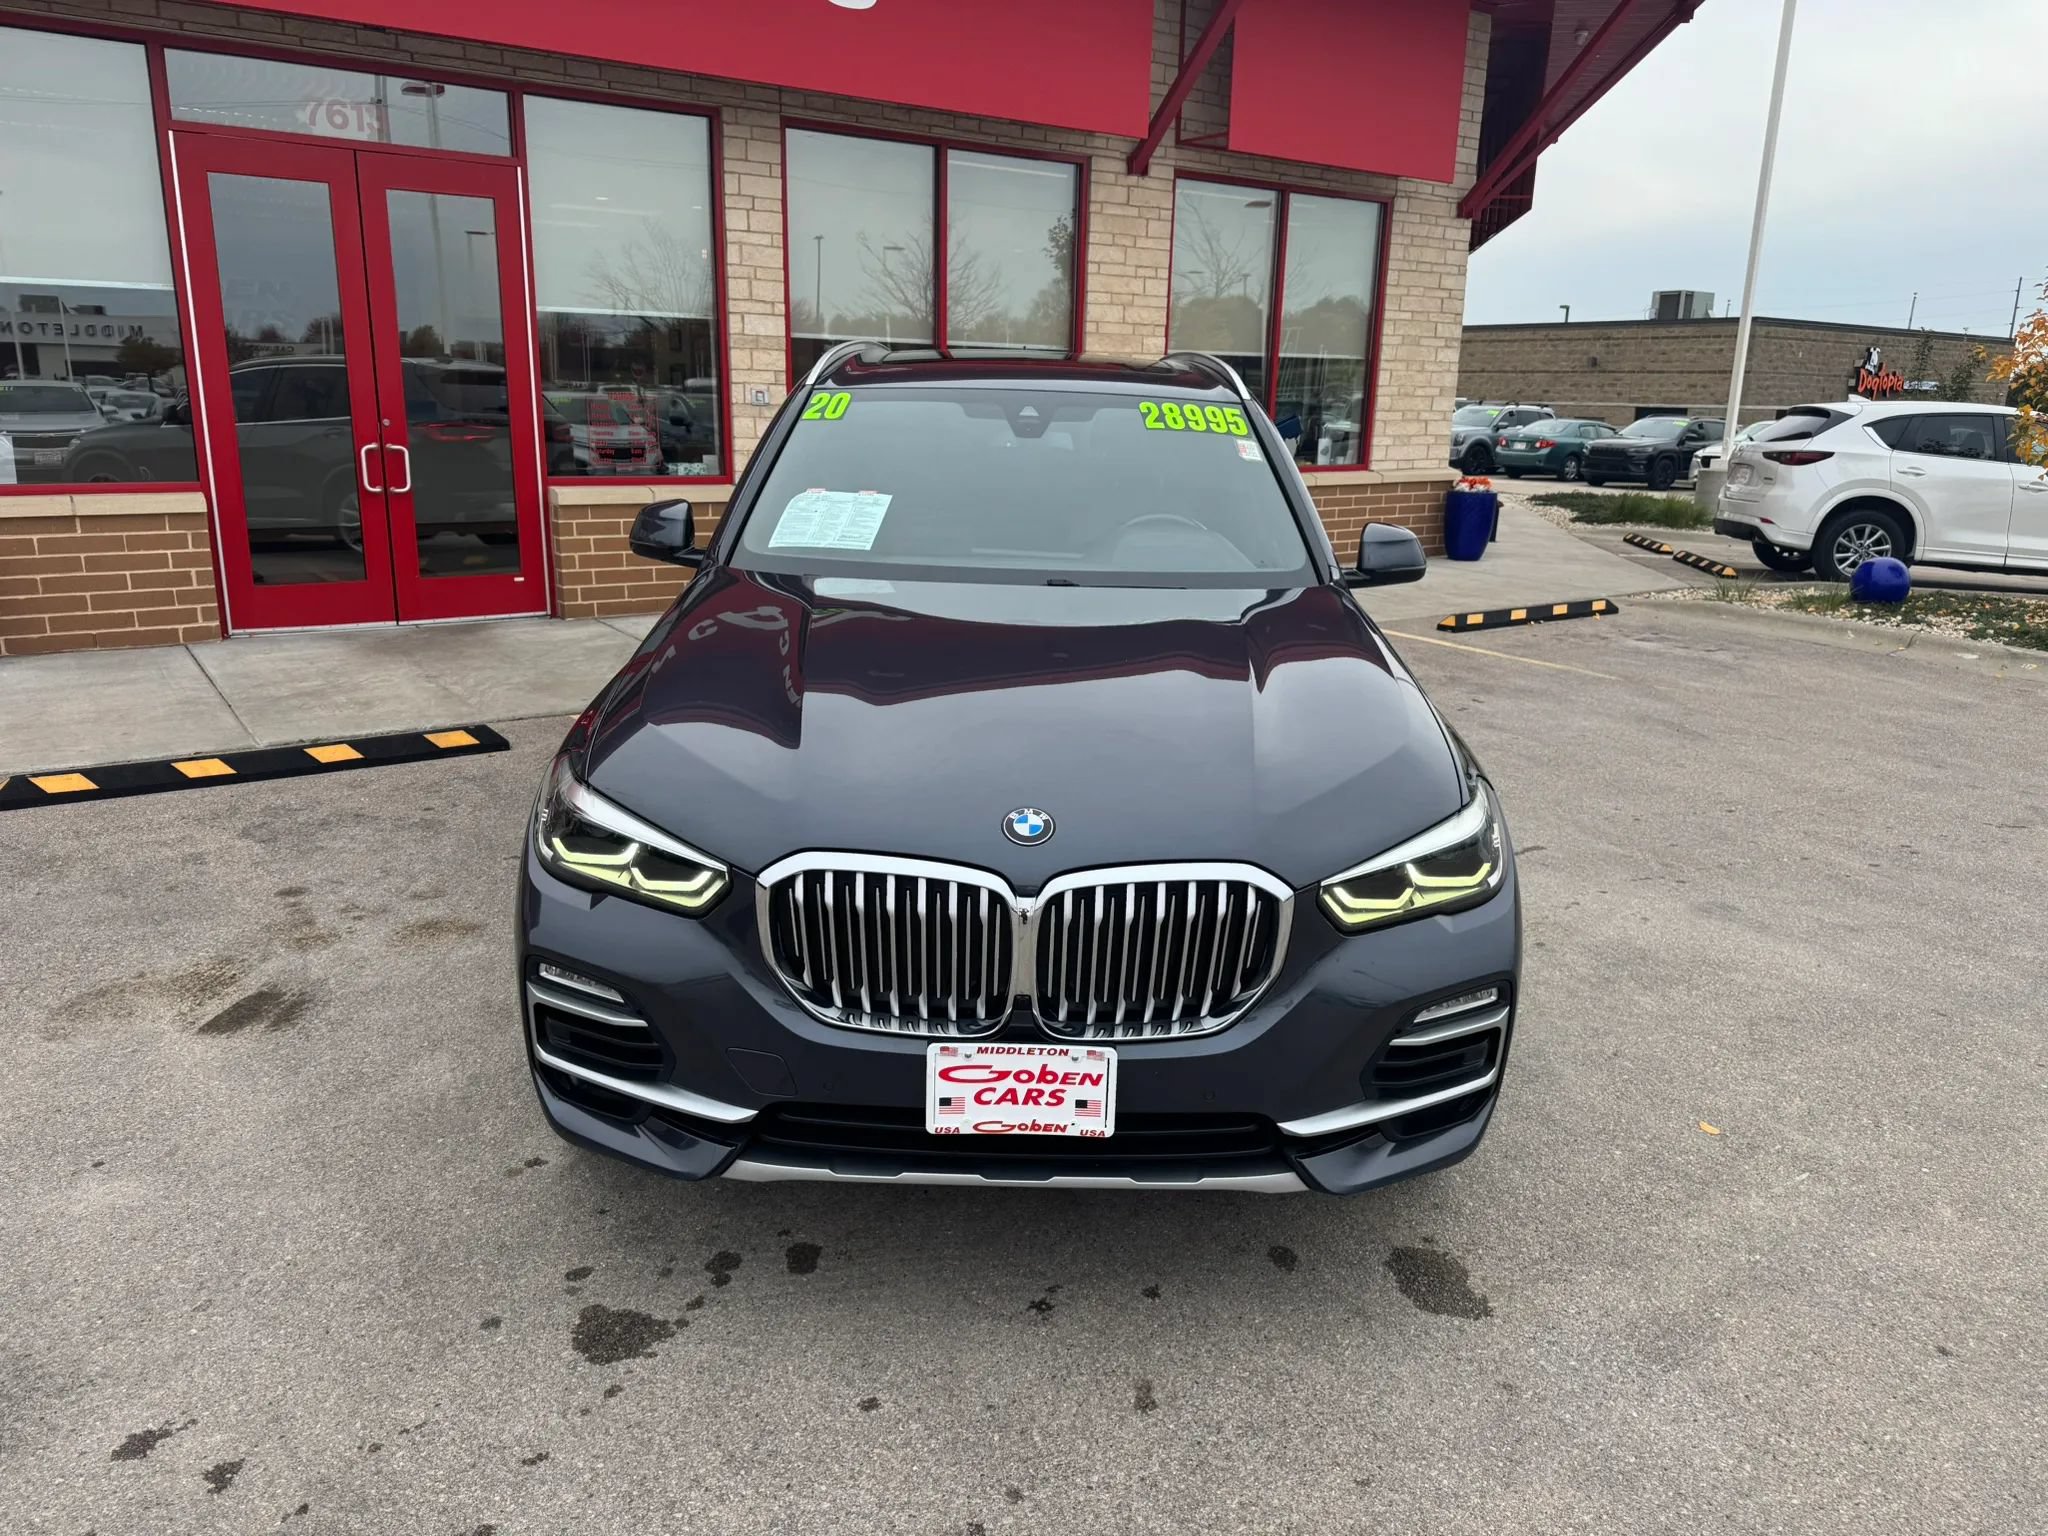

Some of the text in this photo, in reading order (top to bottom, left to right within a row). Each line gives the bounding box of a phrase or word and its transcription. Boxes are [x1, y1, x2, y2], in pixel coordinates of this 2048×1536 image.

[1858, 362, 1904, 400] Dogtopia
[802, 392, 851, 420] 20
[1139, 401, 1248, 436] 28995
[1008, 808, 1050, 820] BMW
[976, 1046, 1070, 1057] MIDDLETON
[973, 1087, 1067, 1107] CARS
[934, 1126, 961, 1134] USA
[1079, 1129, 1106, 1137] USA
